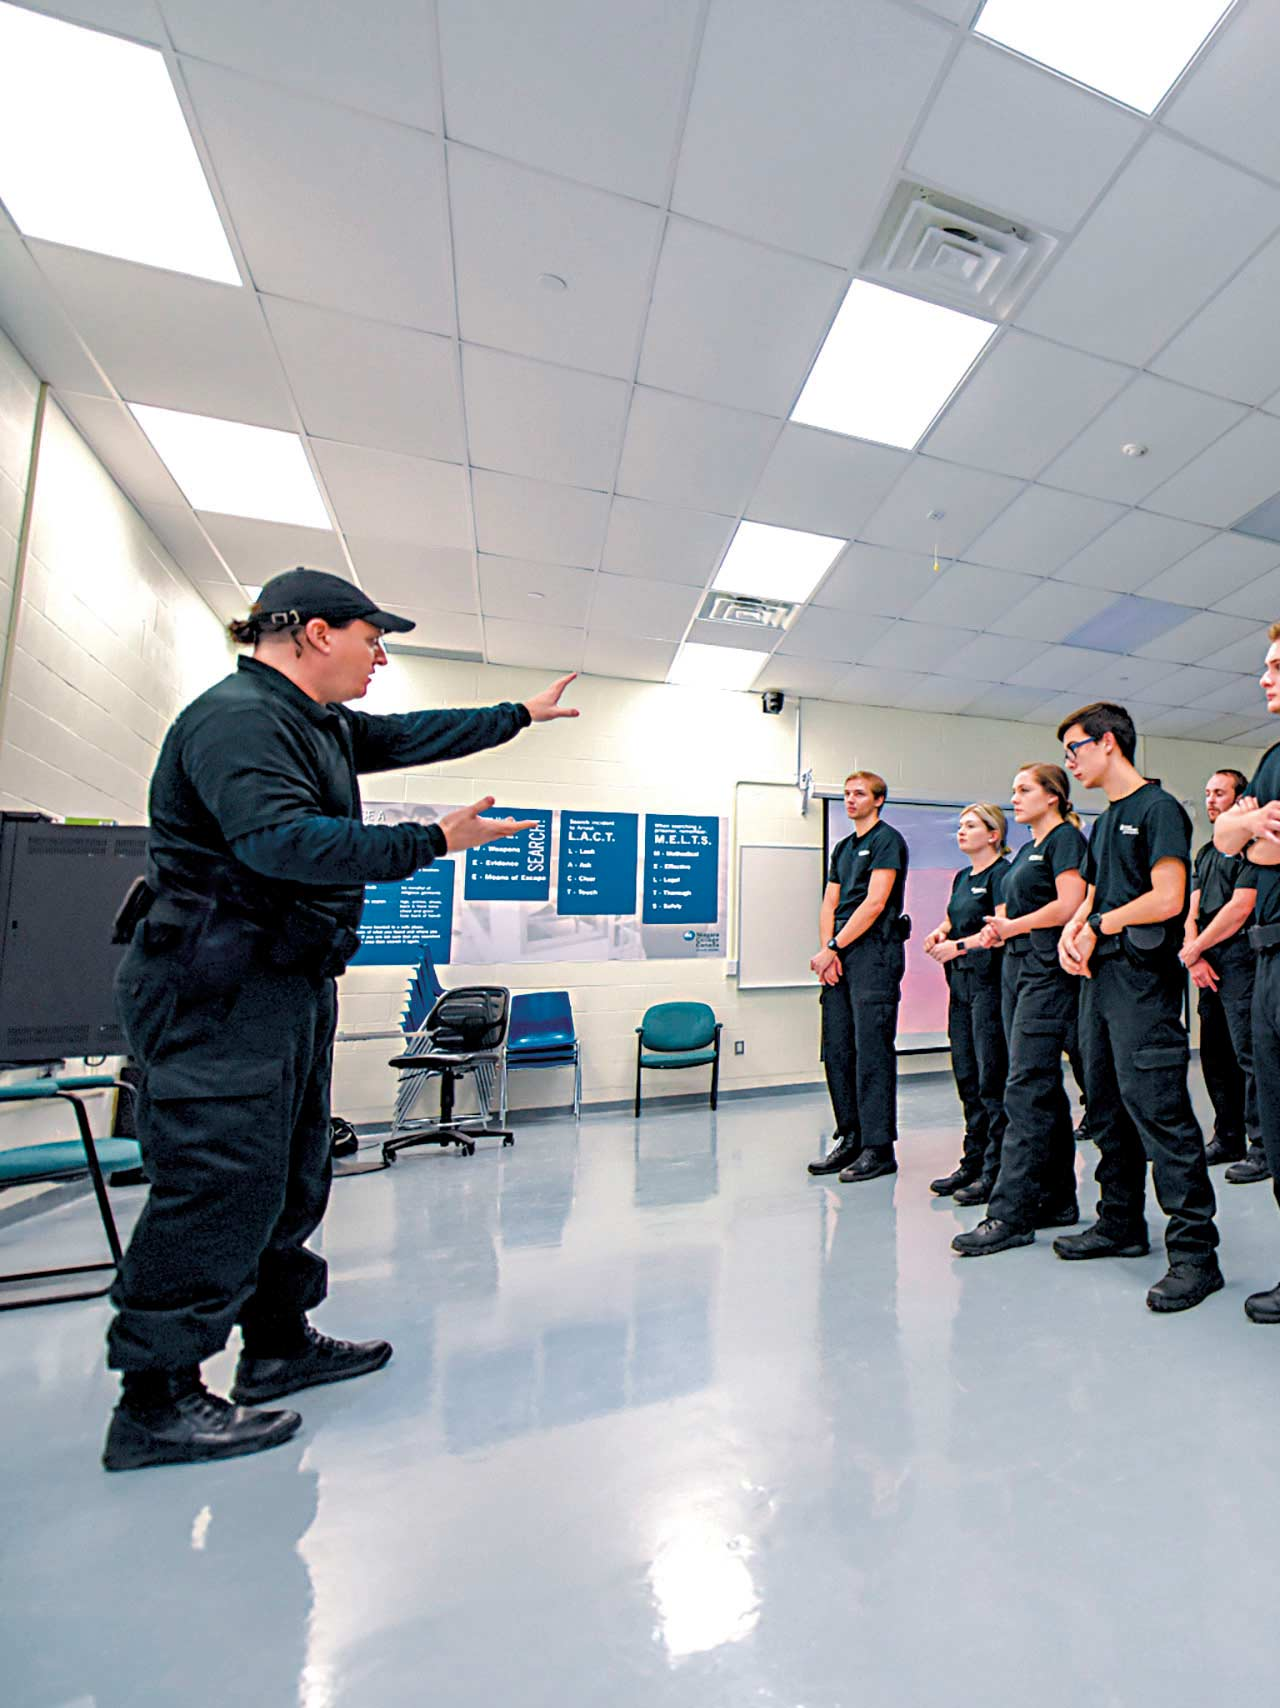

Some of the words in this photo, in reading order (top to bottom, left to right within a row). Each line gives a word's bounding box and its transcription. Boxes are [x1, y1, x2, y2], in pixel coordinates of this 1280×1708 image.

[568, 831, 616, 842] L.A.C.T.
[654, 834, 712, 846] M.E.L.T.S.
[488, 846, 521, 854] Weapons
[485, 859, 519, 867] Evidence
[484, 873, 509, 881] Means
[511, 873, 519, 881] of
[521, 874, 547, 882] Escape
